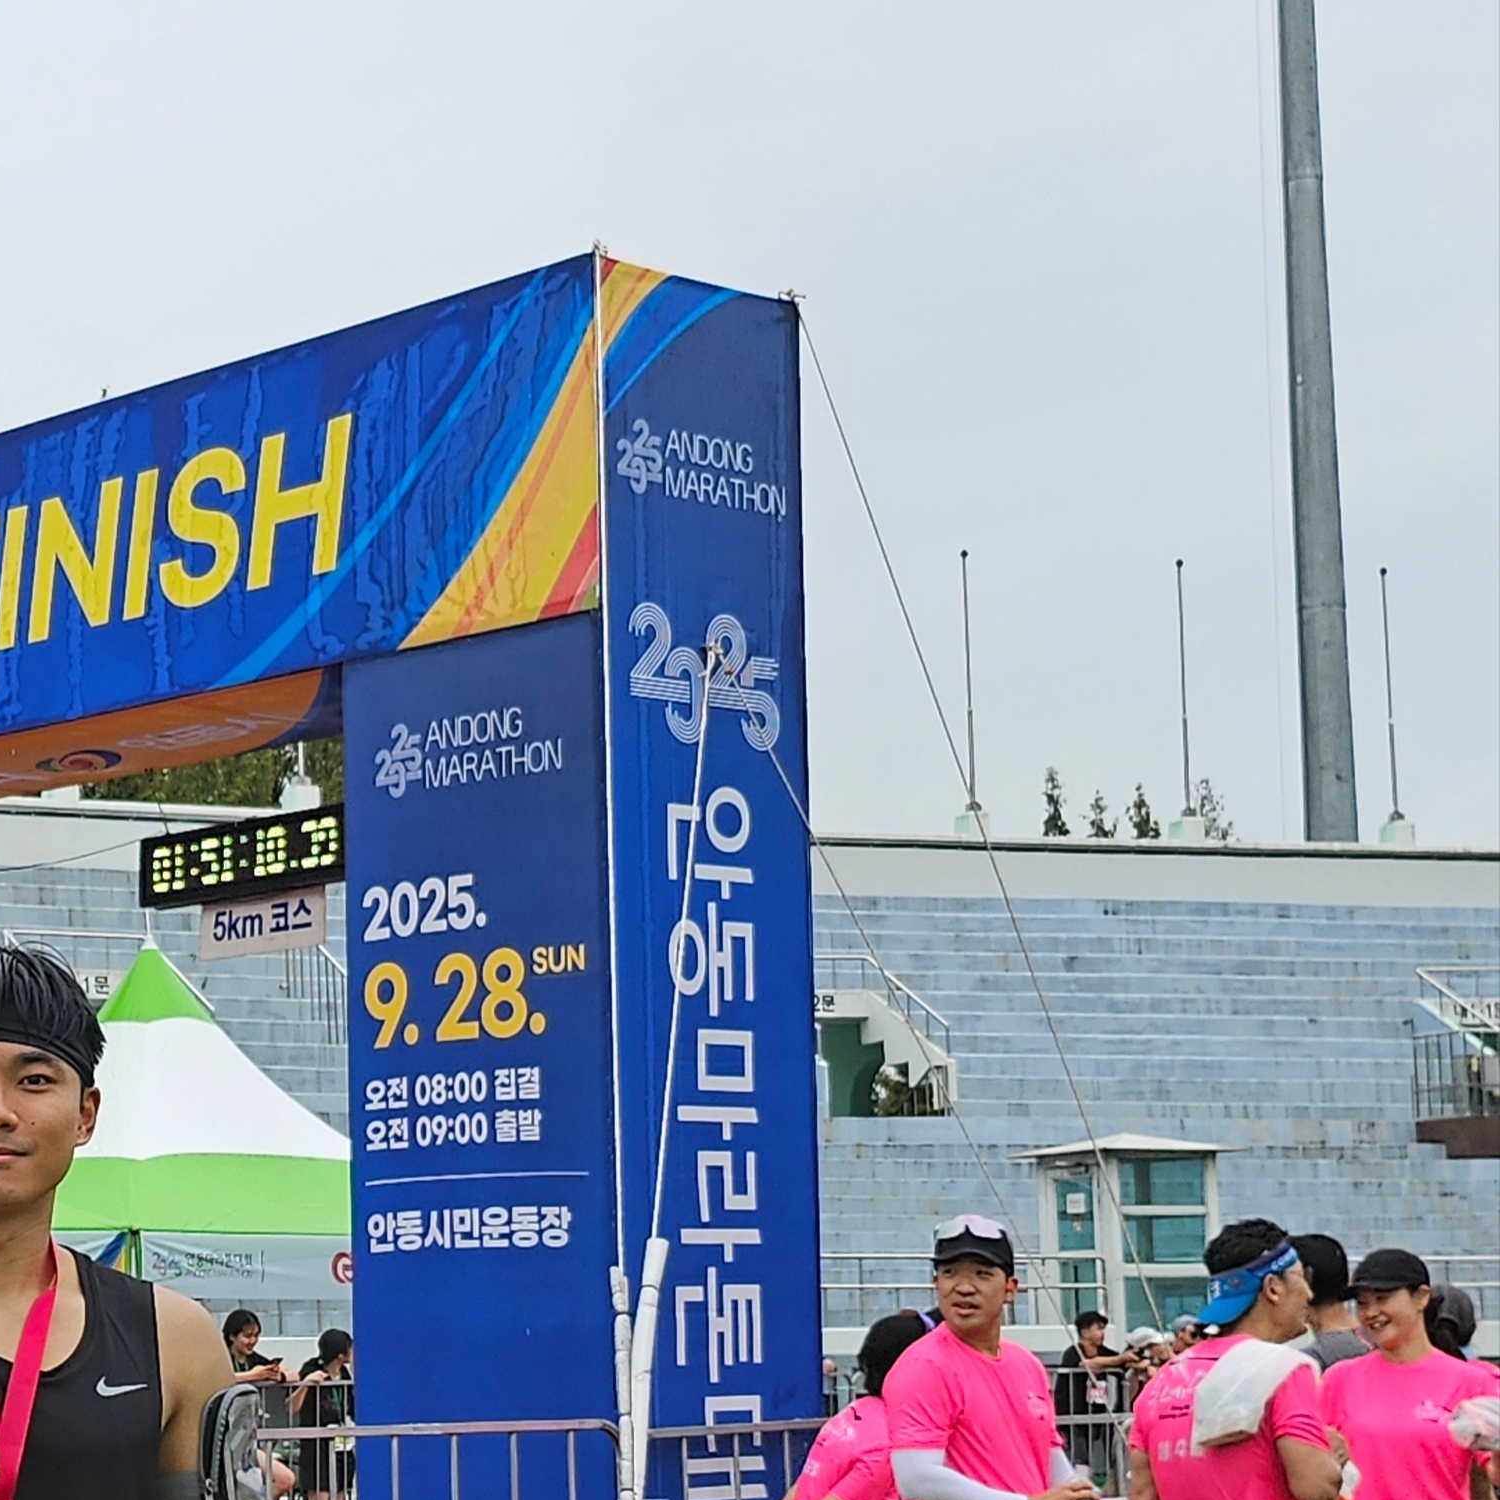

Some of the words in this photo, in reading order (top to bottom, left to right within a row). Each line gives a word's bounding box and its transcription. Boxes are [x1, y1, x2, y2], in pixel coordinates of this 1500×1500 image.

[663, 429, 755, 477] ANDONG
[663, 463, 788, 523] MARATHON
[424, 706, 524, 752] ANDONG
[424, 738, 563, 789] MARATHON
[212, 909, 264, 942] 5km
[269, 897, 313, 934] 코스
[362, 873, 487, 942] 2025.
[363, 962, 420, 1050] 9.
[433, 946, 547, 1044] 28.
[531, 943, 586, 974] SUN
[364, 1077, 408, 1111] 오전
[414, 1071, 488, 1107] 08:00
[493, 1066, 542, 1101] 집결
[364, 1118, 410, 1152] 오전
[414, 1112, 489, 1147] 09:00
[494, 1108, 542, 1142] 출발
[367, 1206, 572, 1254] 안동시민운동장
